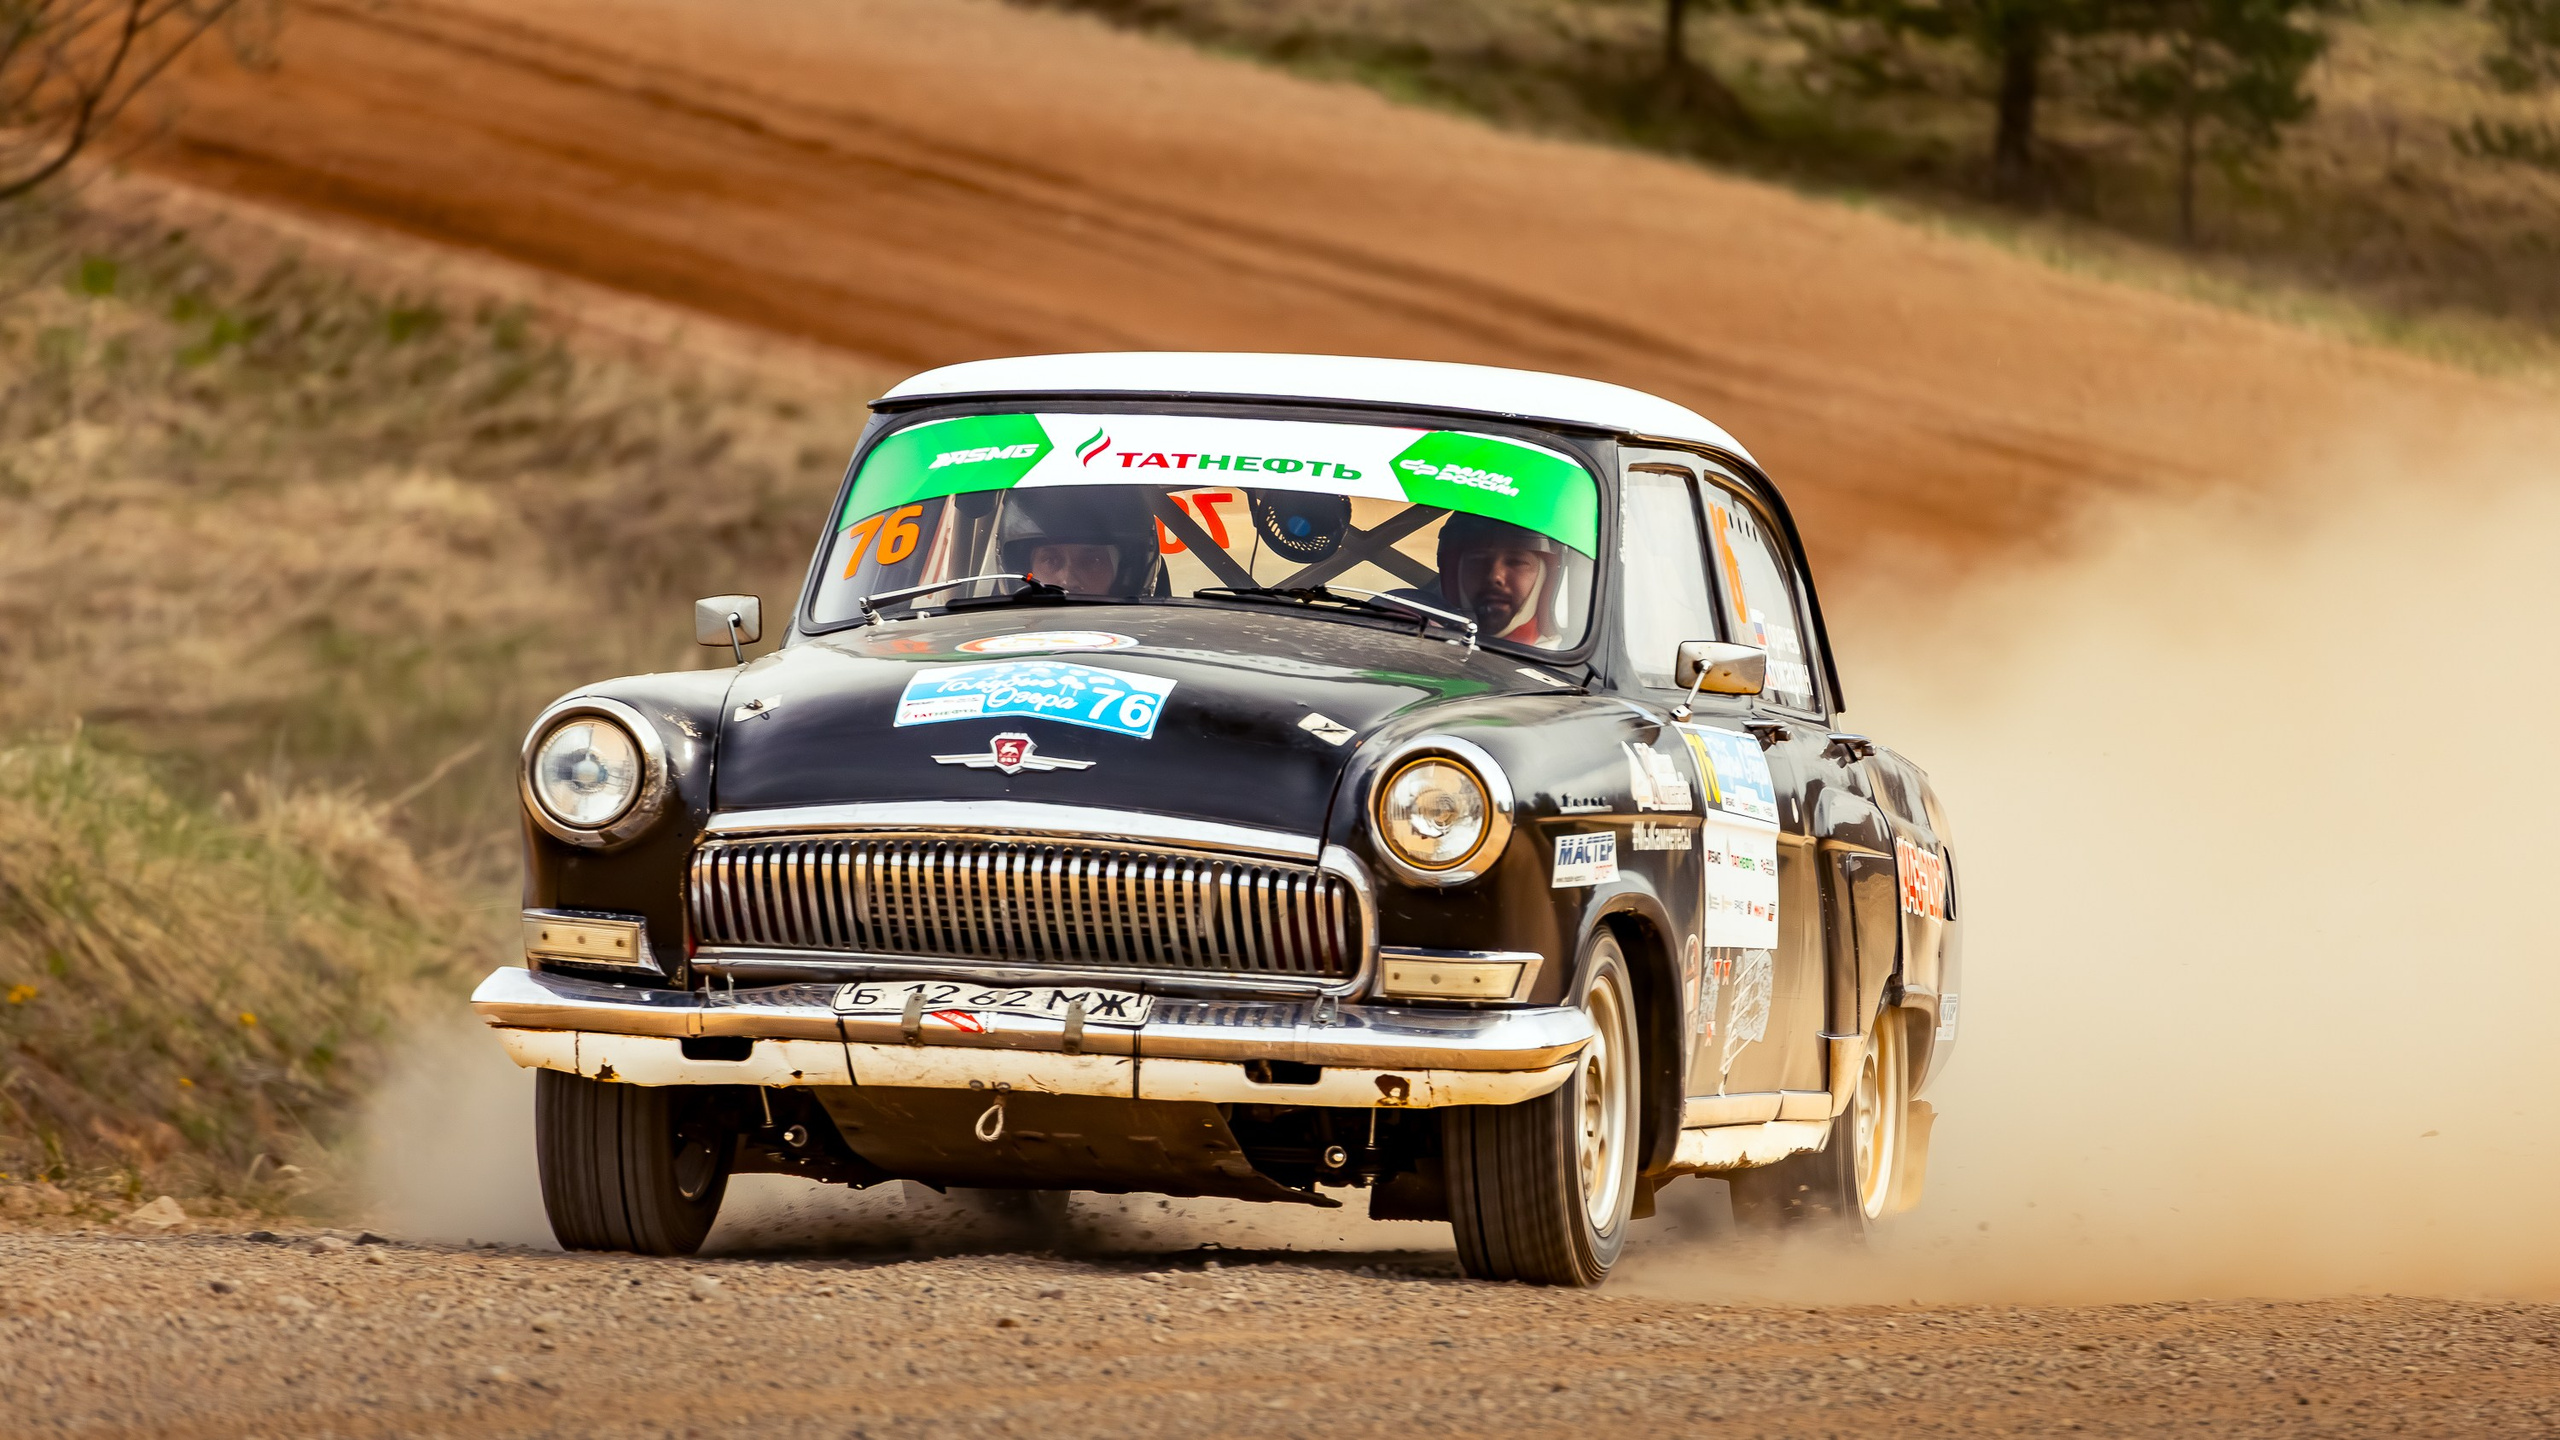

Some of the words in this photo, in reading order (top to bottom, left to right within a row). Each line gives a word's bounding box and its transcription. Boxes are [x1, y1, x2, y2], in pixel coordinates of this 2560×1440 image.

[1116, 452, 1363, 481] ТАТНЕФТЬ
[843, 504, 924, 580] 76
[1088, 686, 1156, 728] 76
[852, 988, 881, 1005] Б
